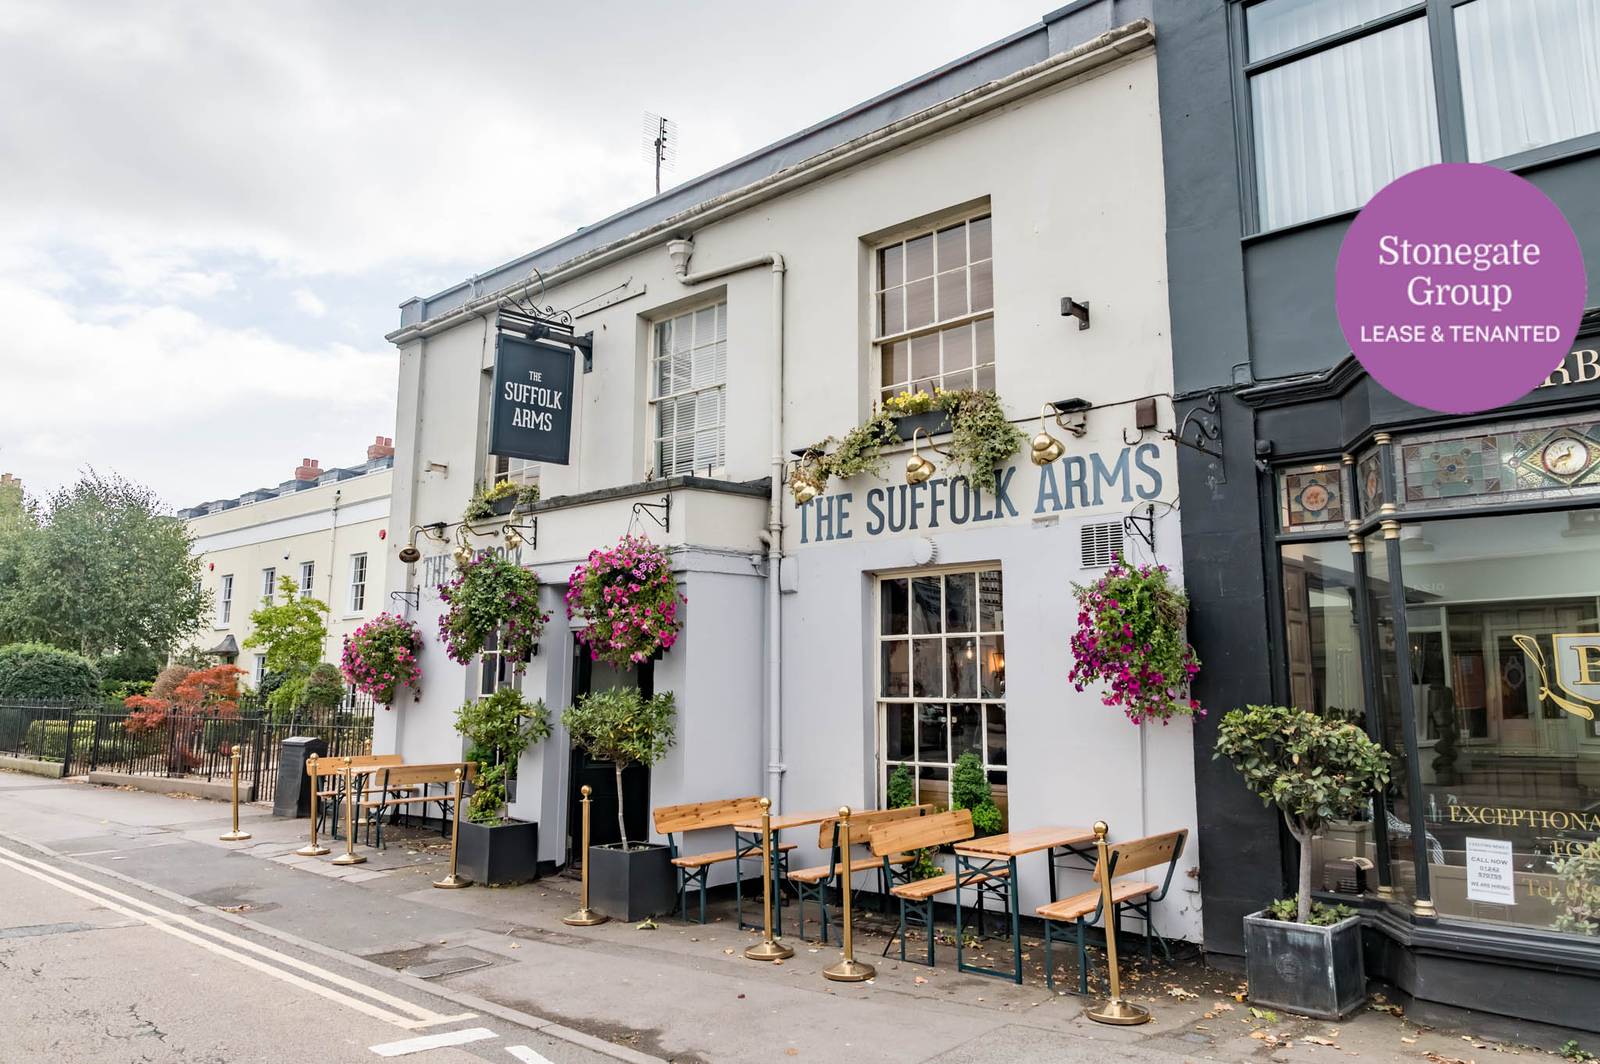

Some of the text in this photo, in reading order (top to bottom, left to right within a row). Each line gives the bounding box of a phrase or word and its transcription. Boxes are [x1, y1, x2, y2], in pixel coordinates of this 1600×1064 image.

[528, 370, 543, 382] THE
[504, 381, 563, 410] SUFFOLK
[512, 408, 553, 431] ARMS
[795, 443, 1164, 544] THE SUFFOLK ARMS
